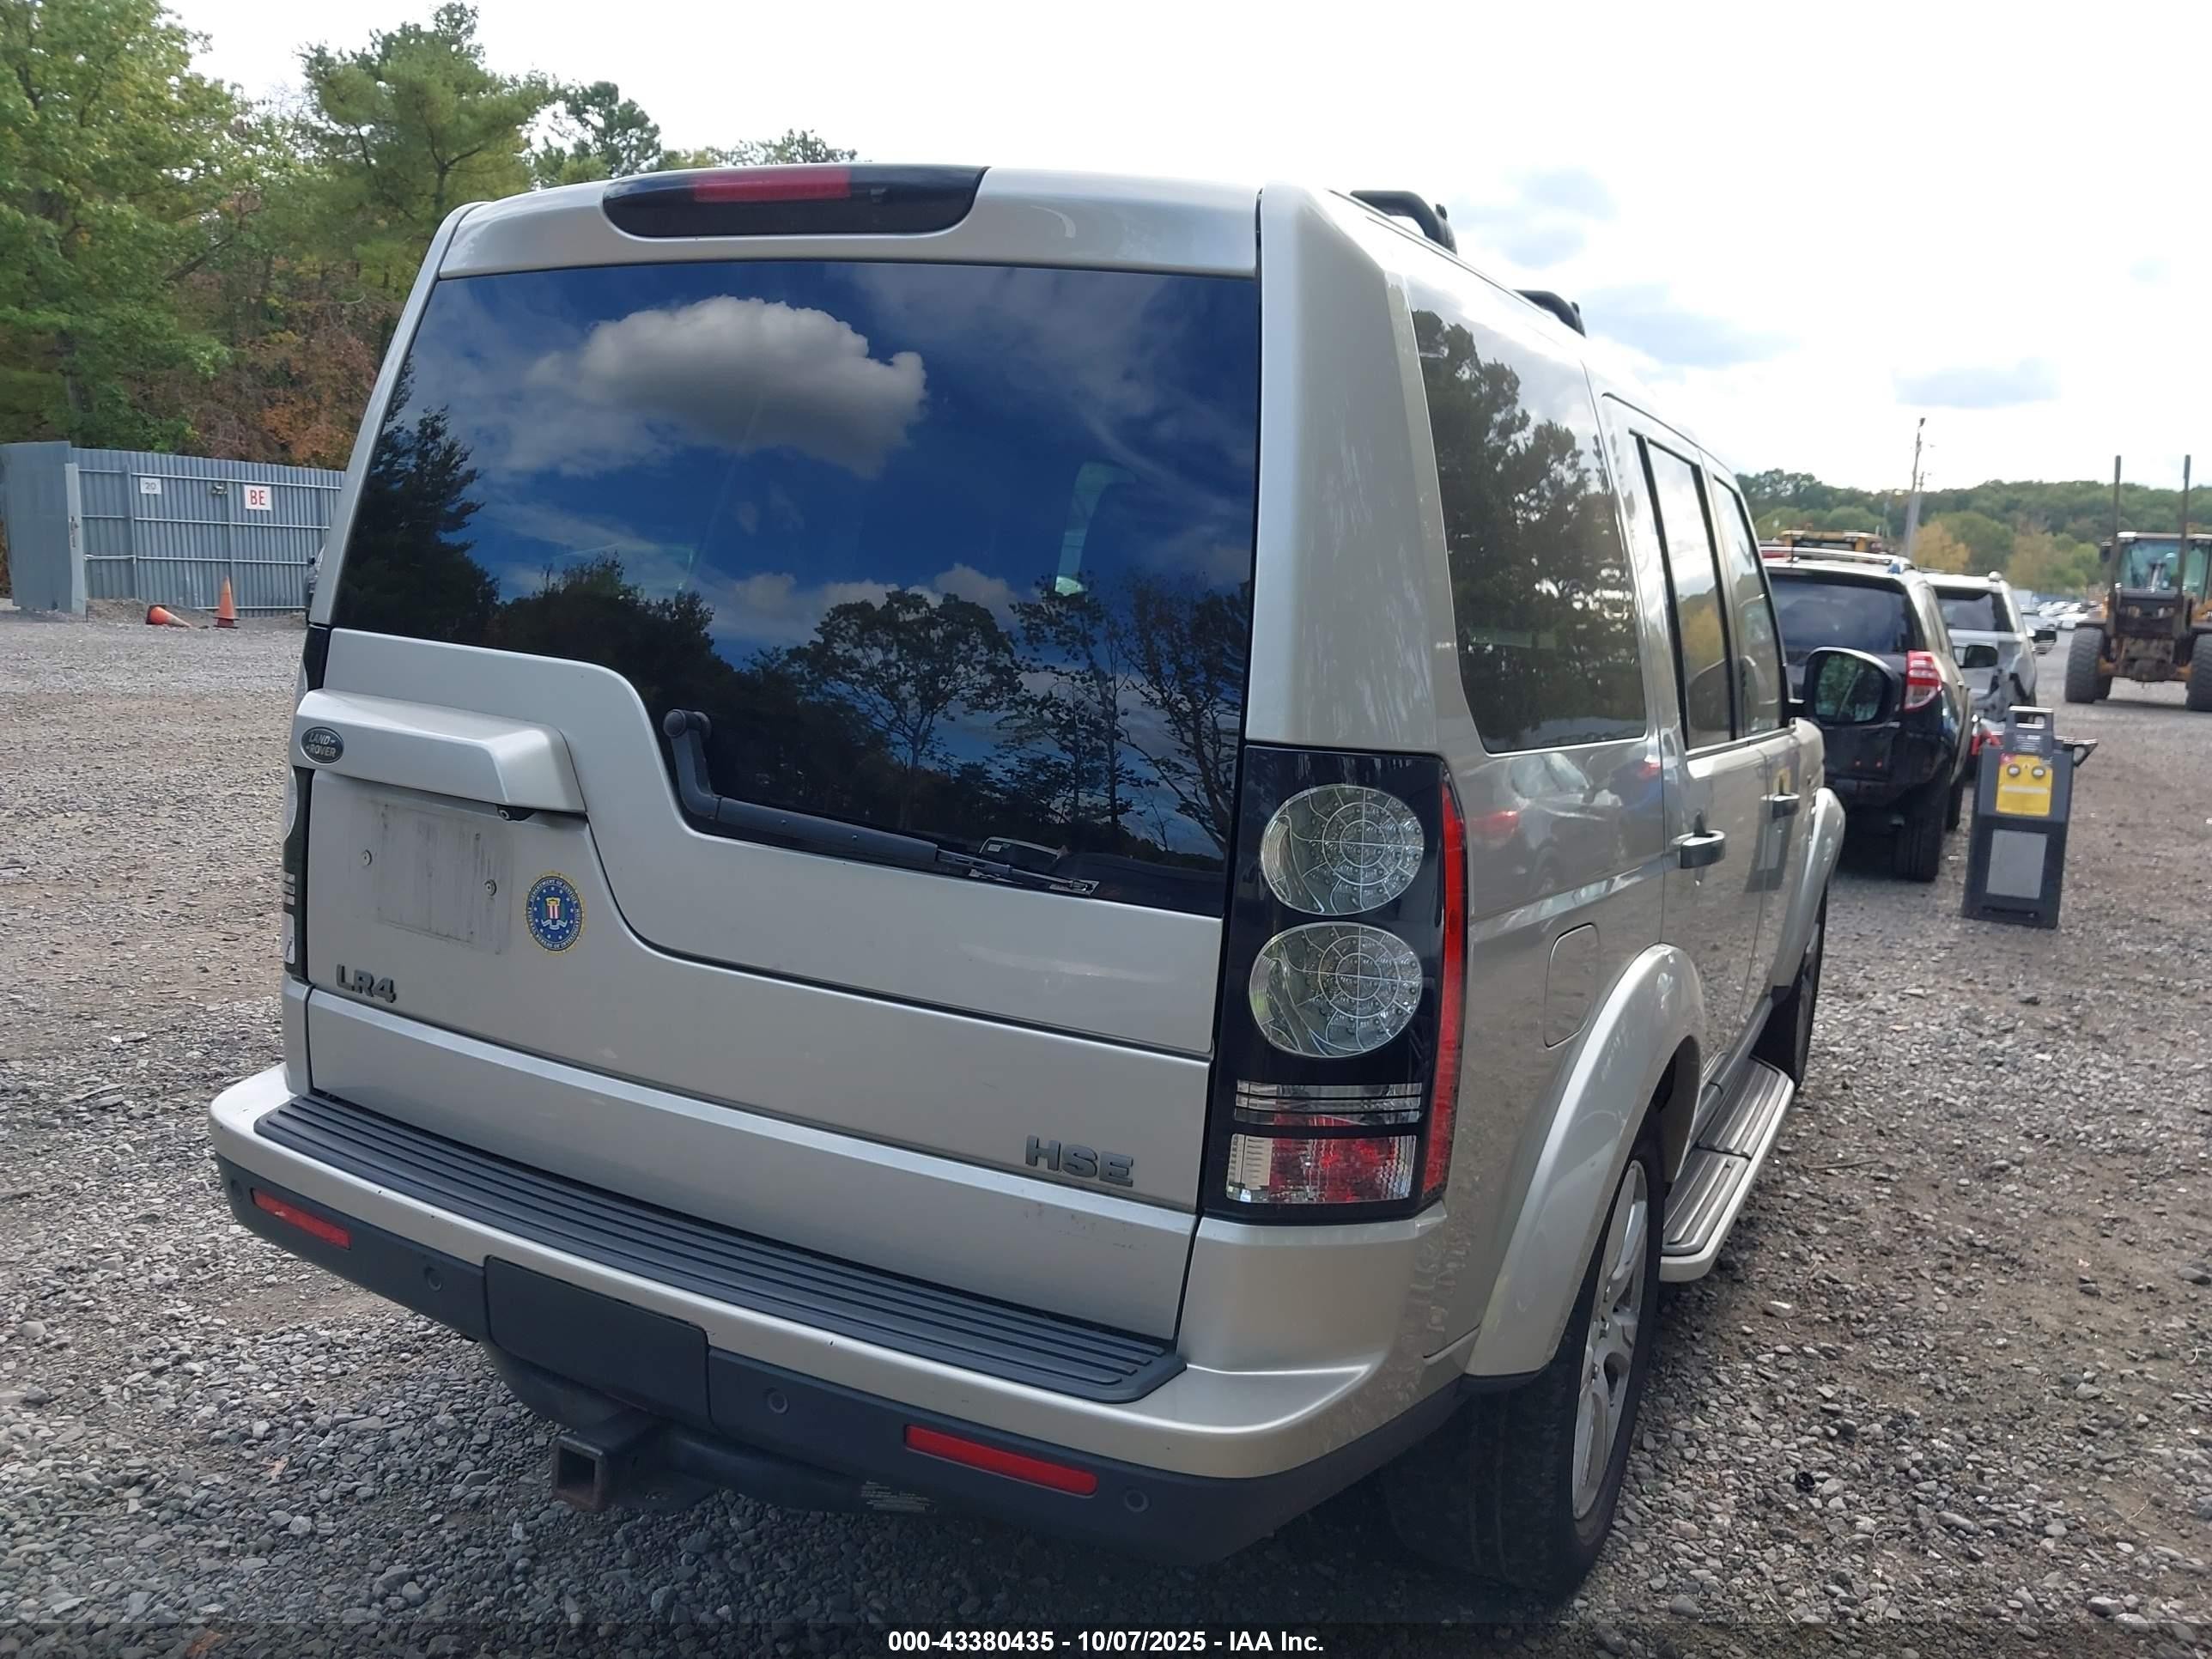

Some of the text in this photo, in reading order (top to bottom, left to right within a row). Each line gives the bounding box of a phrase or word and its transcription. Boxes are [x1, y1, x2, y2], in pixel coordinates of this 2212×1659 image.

[249, 489, 266, 506] BE
[309, 732, 331, 745] LAND
[337, 963, 397, 1003] LR4
[1025, 1133, 1133, 1187] HSE
